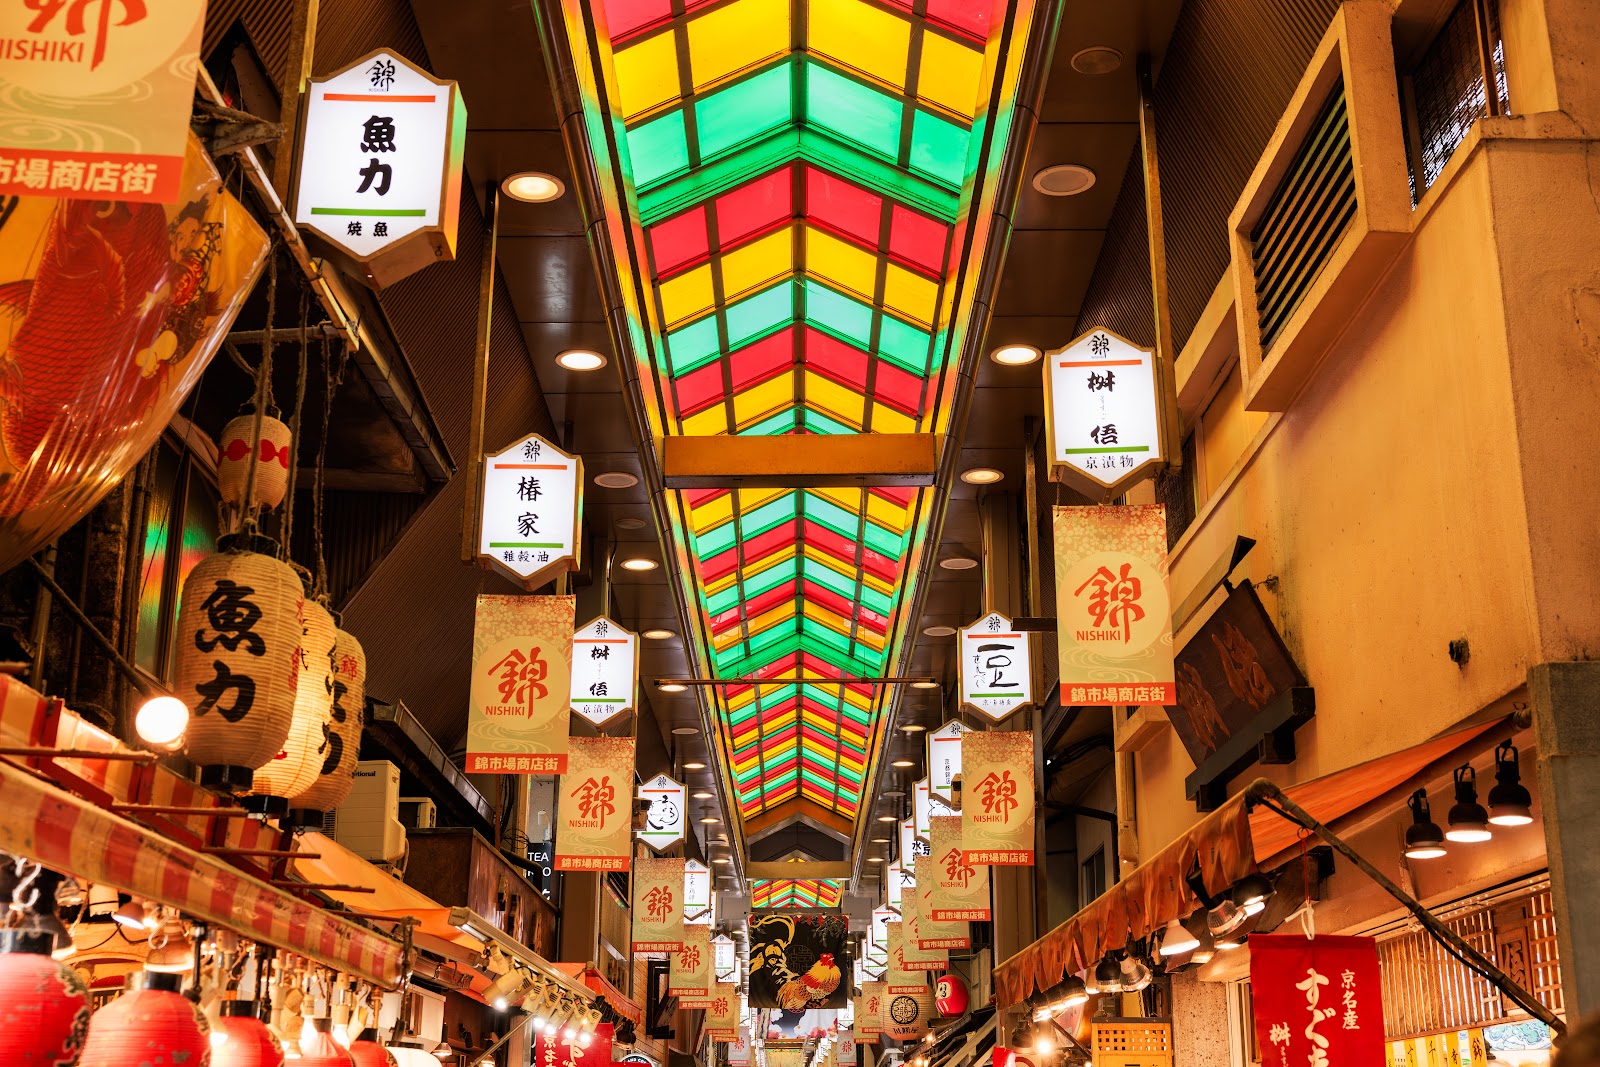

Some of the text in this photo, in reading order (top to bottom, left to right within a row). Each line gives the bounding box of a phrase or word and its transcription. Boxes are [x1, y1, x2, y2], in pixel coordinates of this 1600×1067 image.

[366, 60, 395, 91] 錦
[357, 115, 396, 196] 魚力
[348, 222, 388, 237] 焼魚
[1085, 455, 1134, 469] 京漬物
[516, 476, 543, 537] 椿家
[1074, 563, 1145, 644] 錦
[1077, 631, 1120, 641] NISHIKI
[195, 579, 267, 723] 魚力
[487, 646, 549, 720] 錦
[1071, 687, 1165, 702] 錦市場商店街
[485, 705, 525, 716] NISHIKI
[474, 757, 559, 771] 錦市場商店街
[570, 775, 616, 831] 錦
[973, 770, 1019, 824] 錦
[569, 819, 598, 828] NISHIKI
[973, 815, 1002, 823] NISHIKI
[527, 852, 549, 862] TEA
[561, 858, 623, 869] 錦市場商店街
[968, 852, 1028, 863] 錦市場商店街
[641, 885, 673, 924] 錦
[937, 911, 986, 920] 錦市場商店街
[676, 944, 701, 974] 錦
[1341, 969, 1360, 1030] 京名産
